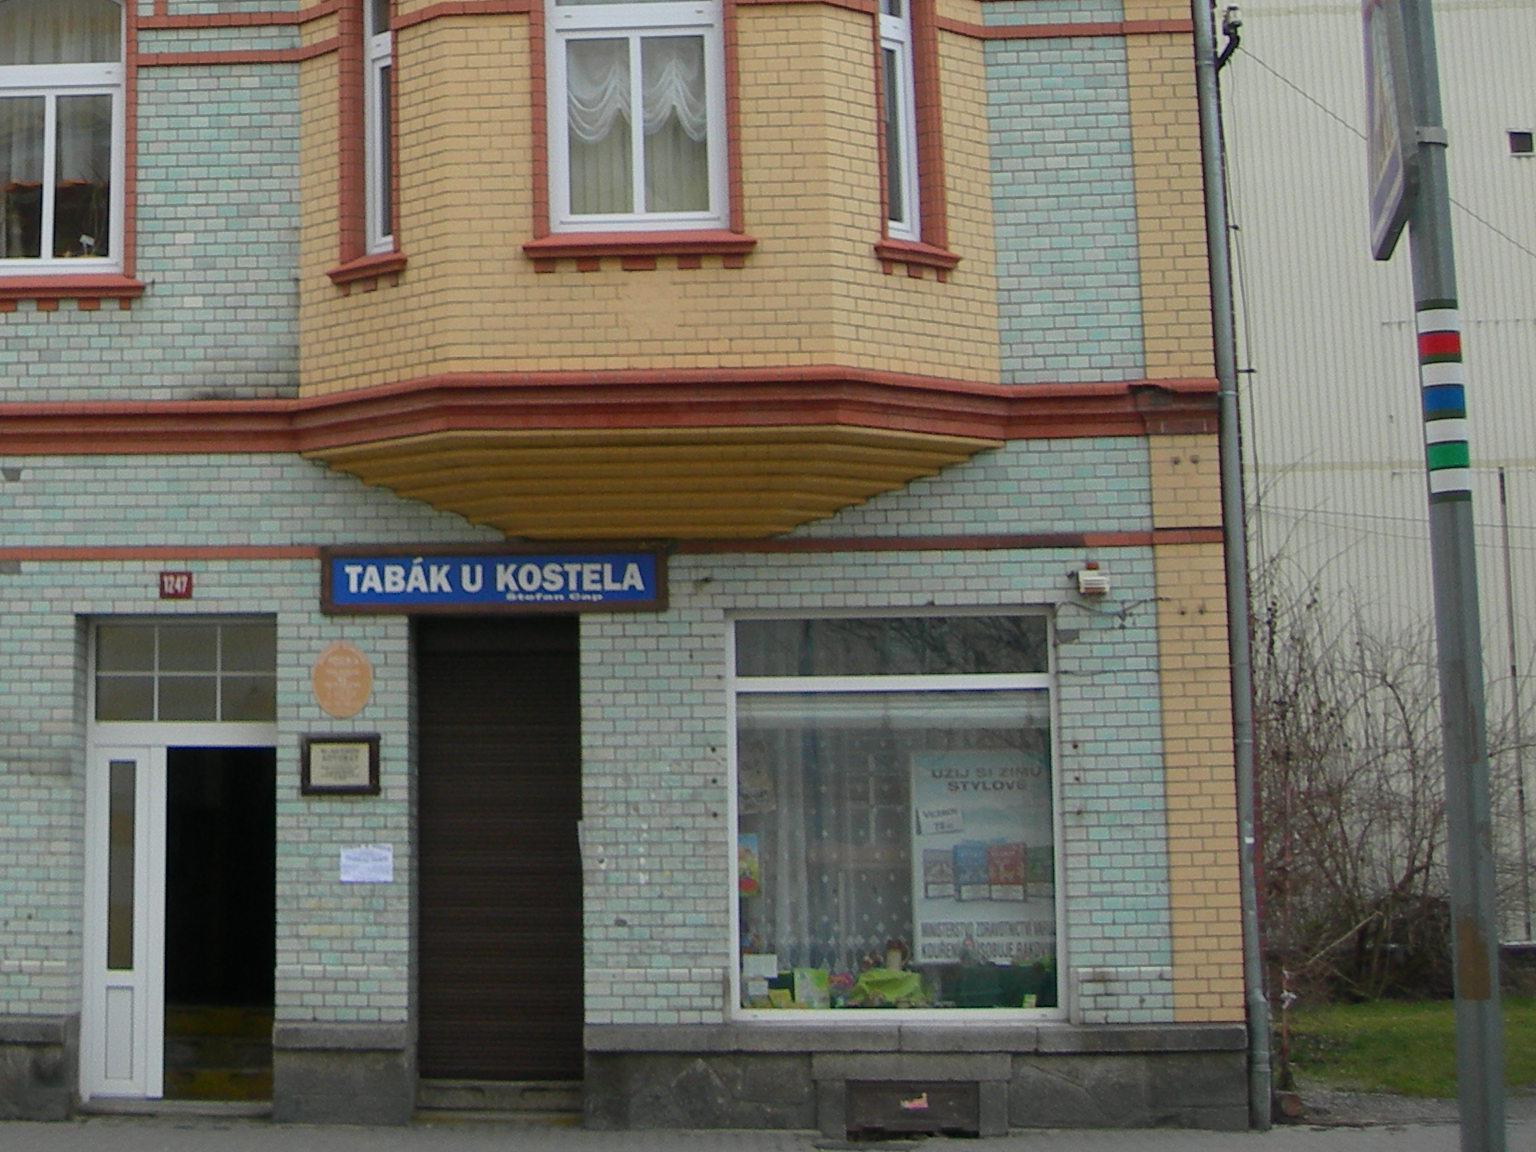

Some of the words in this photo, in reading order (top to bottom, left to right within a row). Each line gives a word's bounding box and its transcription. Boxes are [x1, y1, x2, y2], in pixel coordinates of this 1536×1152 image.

[163, 575, 188, 594] 1247
[344, 556, 452, 593] TABÁK
[461, 564, 483, 593] U
[496, 563, 644, 592] KOSTELA
